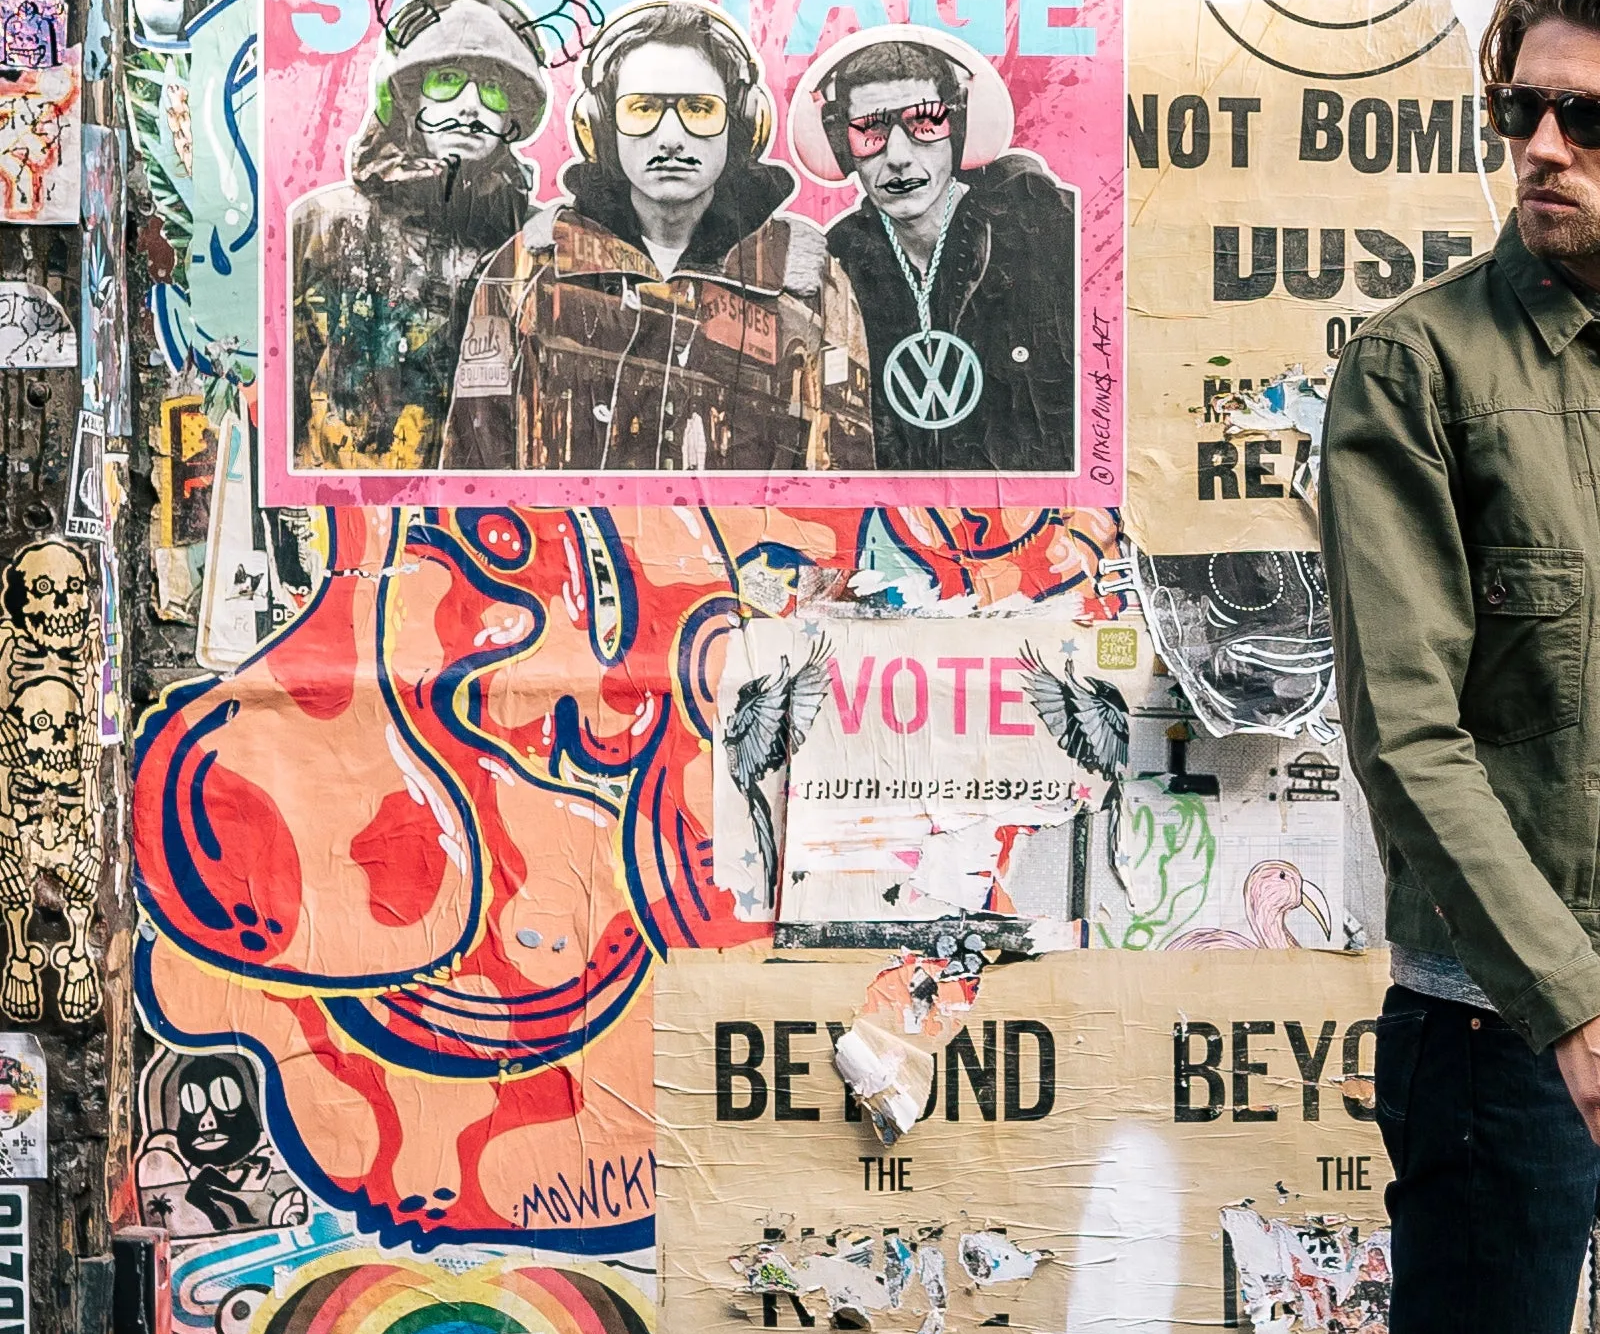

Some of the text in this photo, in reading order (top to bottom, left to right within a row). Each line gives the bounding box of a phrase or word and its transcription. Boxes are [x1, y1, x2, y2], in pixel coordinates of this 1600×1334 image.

[1126, 94, 1261, 169] NOT
[827, 657, 1036, 738] VOTE
[859, 1156, 913, 1192] THE
[1317, 1156, 1372, 1191] THE
